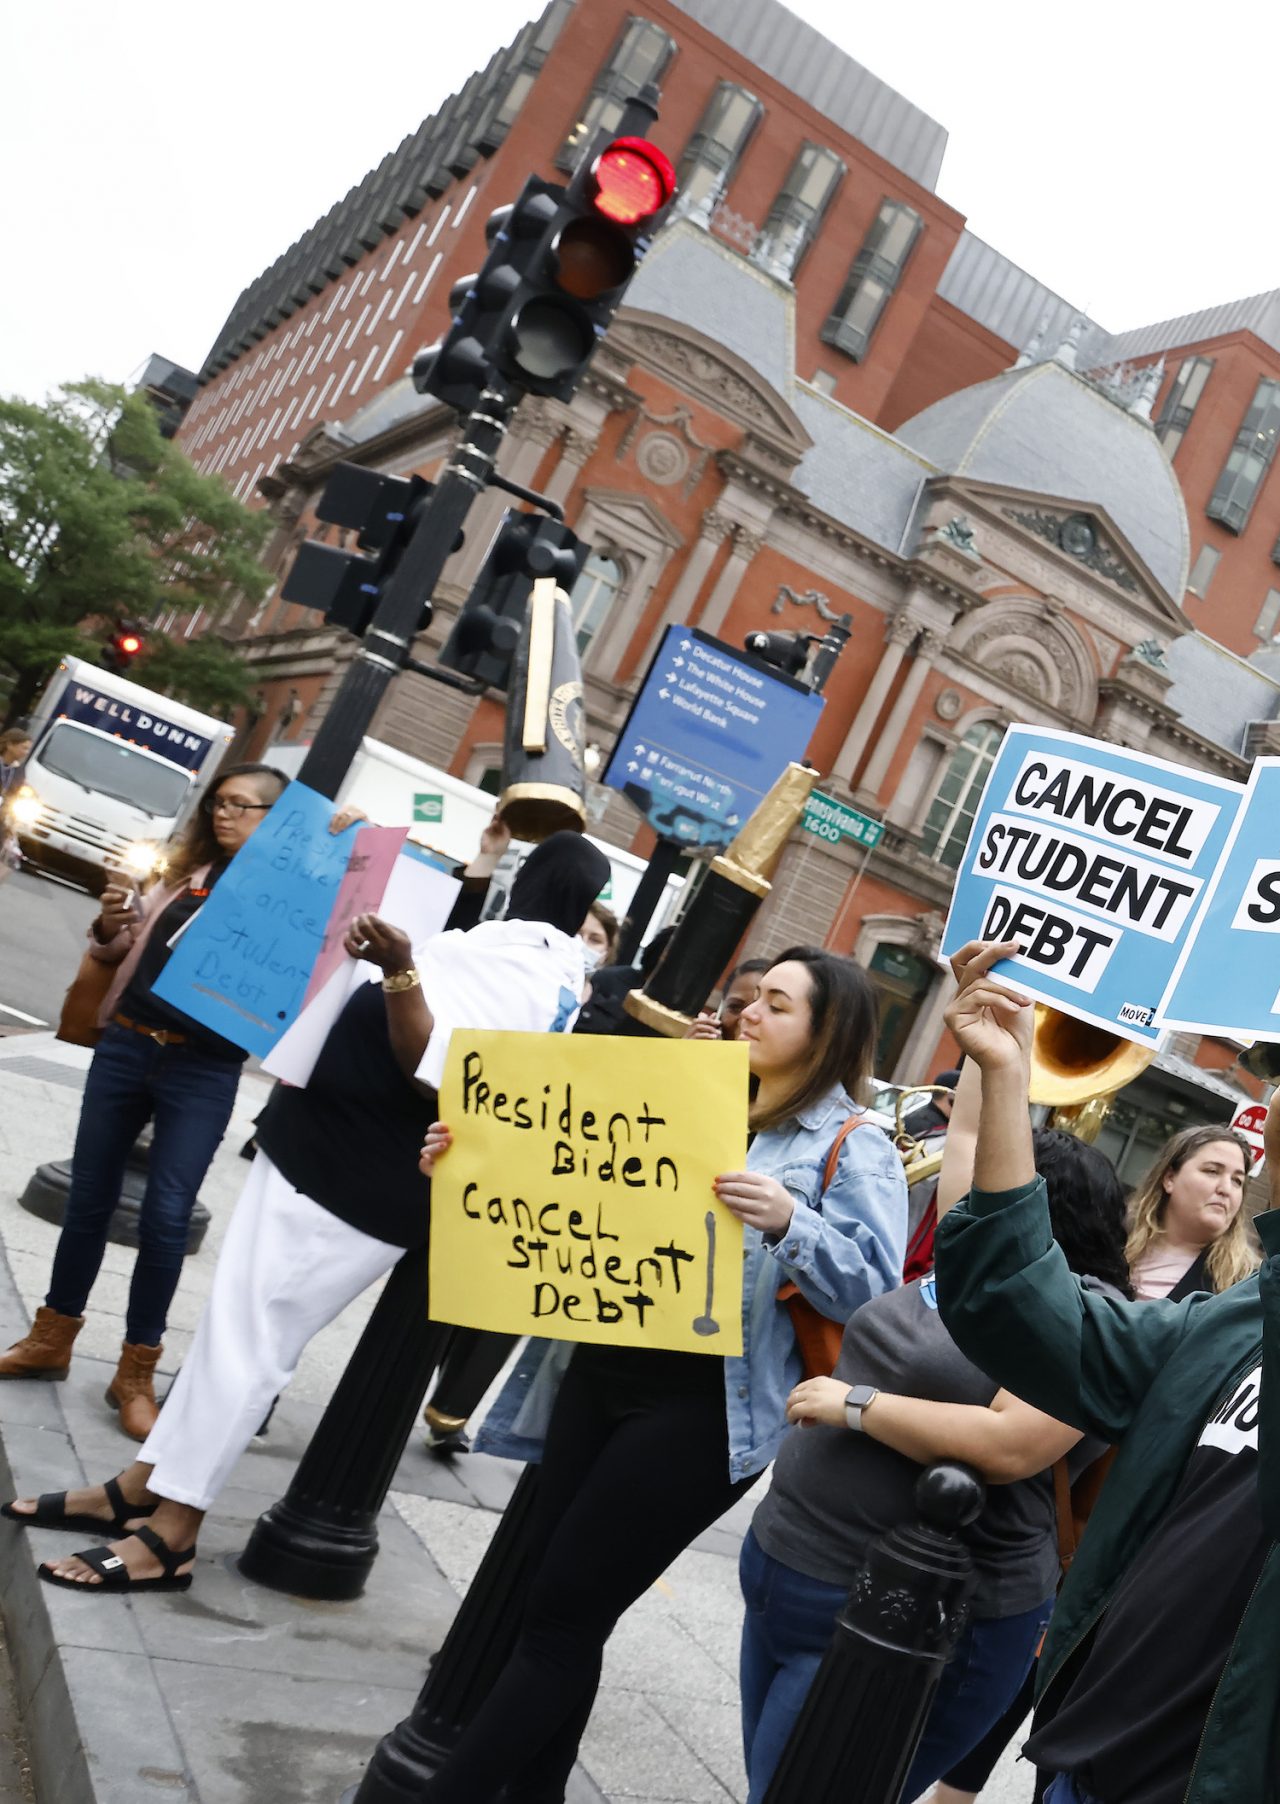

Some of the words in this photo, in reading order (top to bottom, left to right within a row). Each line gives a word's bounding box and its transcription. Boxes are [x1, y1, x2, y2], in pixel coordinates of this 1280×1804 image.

[687, 661, 706, 678] The
[706, 671, 735, 693] White
[734, 686, 766, 709] House
[731, 666, 763, 689] House
[75, 687, 132, 722] WELL
[136, 713, 201, 750] DUNN
[672, 694, 704, 716] World
[702, 708, 727, 728] Bank
[724, 700, 759, 724] Square
[804, 796, 864, 837] ennsylvania
[804, 815, 840, 841] 1600
[1014, 762, 1194, 860] CANCEL
[979, 824, 1195, 930] STUDENT
[236, 874, 328, 940] Cance
[982, 895, 1113, 978] DEBT
[1121, 1006, 1156, 1026] MOVEO
[552, 1141, 679, 1191] Biden
[531, 1281, 655, 1328] Debt
